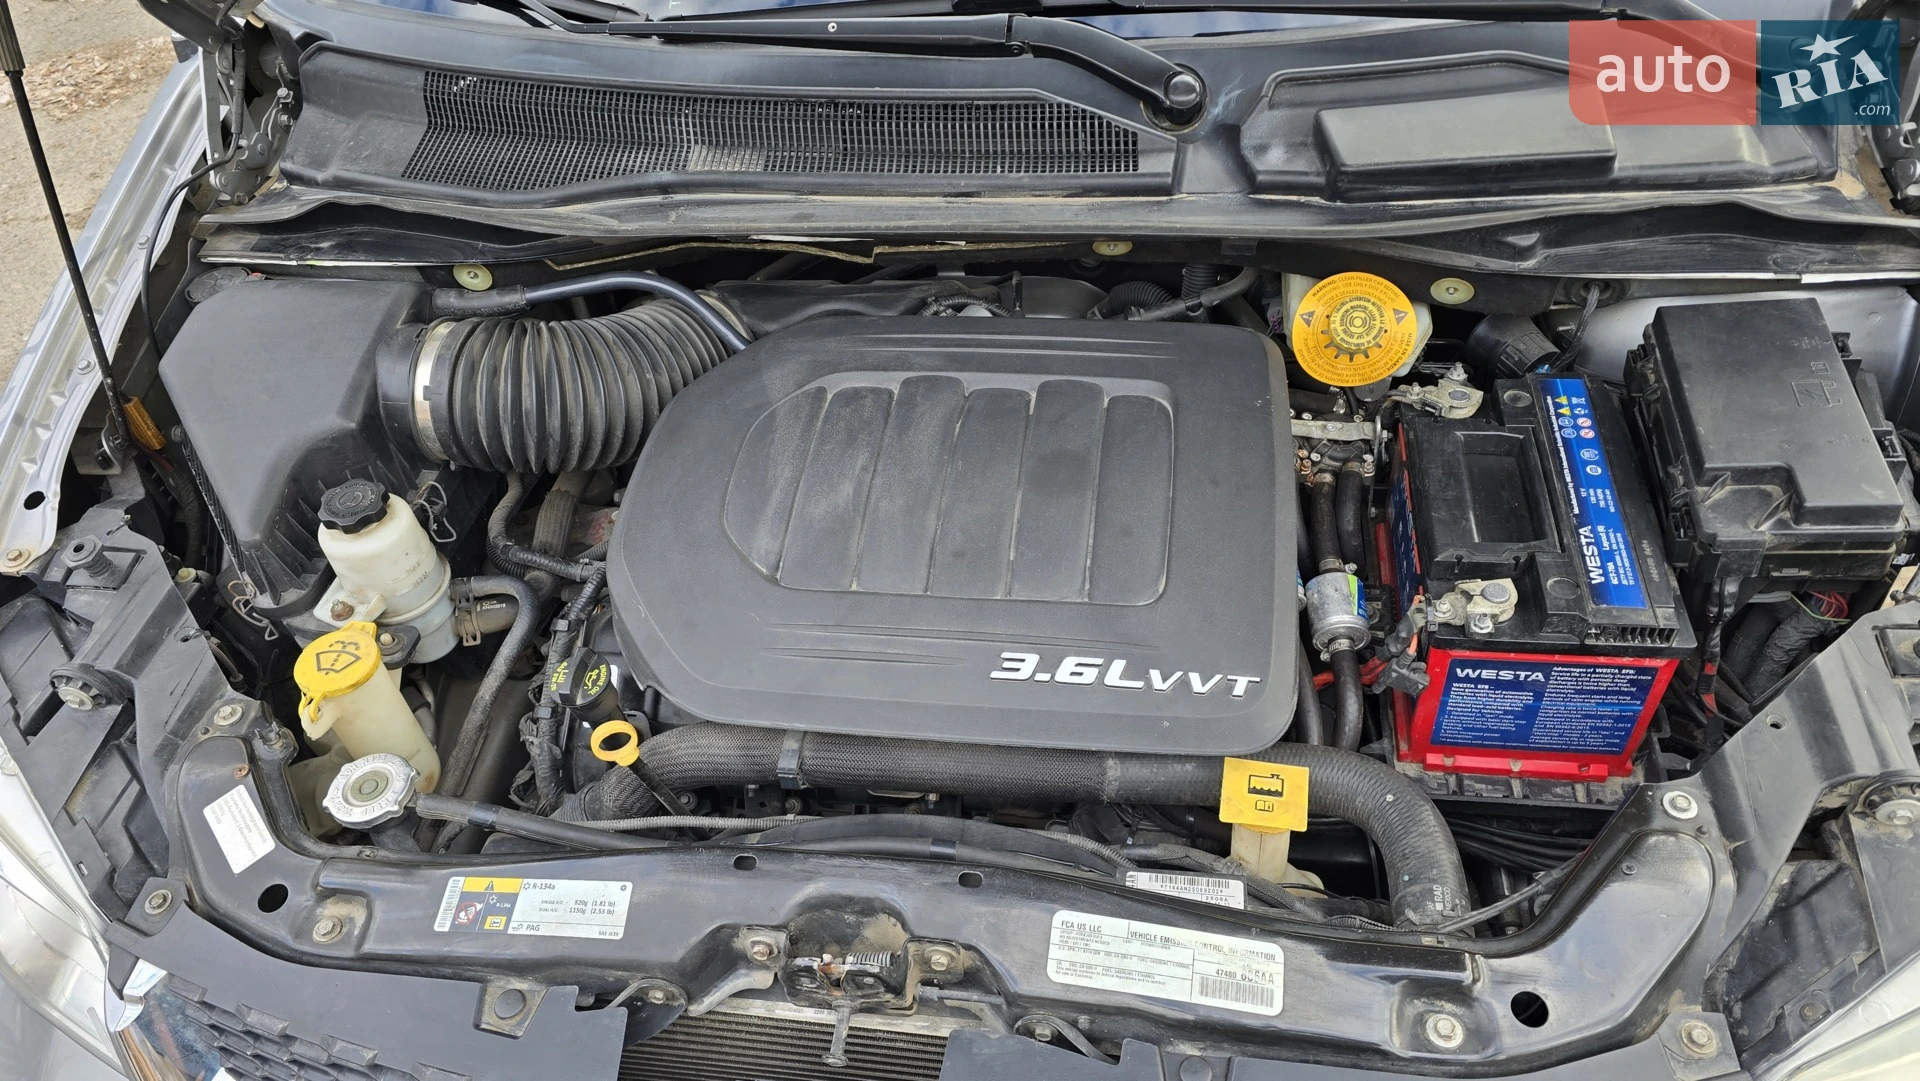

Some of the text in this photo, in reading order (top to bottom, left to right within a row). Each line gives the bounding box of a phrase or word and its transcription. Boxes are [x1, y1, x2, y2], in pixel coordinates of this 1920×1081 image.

[1312, 280, 1337, 296] WARNING:
[1384, 284, 1400, 298] BEFORE
[1384, 290, 1396, 303] FLUID
[1322, 296, 1334, 308] FROM
[1303, 337, 1312, 358] LIQUIDE
[1401, 346, 1408, 355] EN
[1297, 348, 1318, 374] REMPLISSAGE
[1323, 358, 1350, 370] CONTENANT
[1366, 346, 1392, 368] PROVENANT
[1385, 356, 1402, 370] GARDE
[1315, 362, 1344, 376] UNIQUEMENT
[1357, 370, 1382, 382] NETTOYER
[1546, 396, 1555, 414] Corporation
[1550, 416, 1558, 430] Industrial
[1554, 430, 1562, 446] Scientific
[1558, 446, 1568, 468] International
[1563, 468, 1572, 481] WESTA
[1568, 487, 1580, 513] Manufactured
[1598, 532, 1610, 550] Layout
[1576, 524, 1606, 584] WESTA
[556, 662, 567, 672] SAE
[990, 652, 1262, 698] 3.6L VVT
[1454, 668, 1548, 681] WESTA
[588, 664, 606, 695] ENGINE OIL
[1433, 884, 1443, 902] RAD
[1060, 920, 1101, 932] FCA US LLC
[1129, 930, 1157, 942] VEHICLE
[1160, 936, 1192, 948] EMISS
[1215, 968, 1236, 978] 47480
